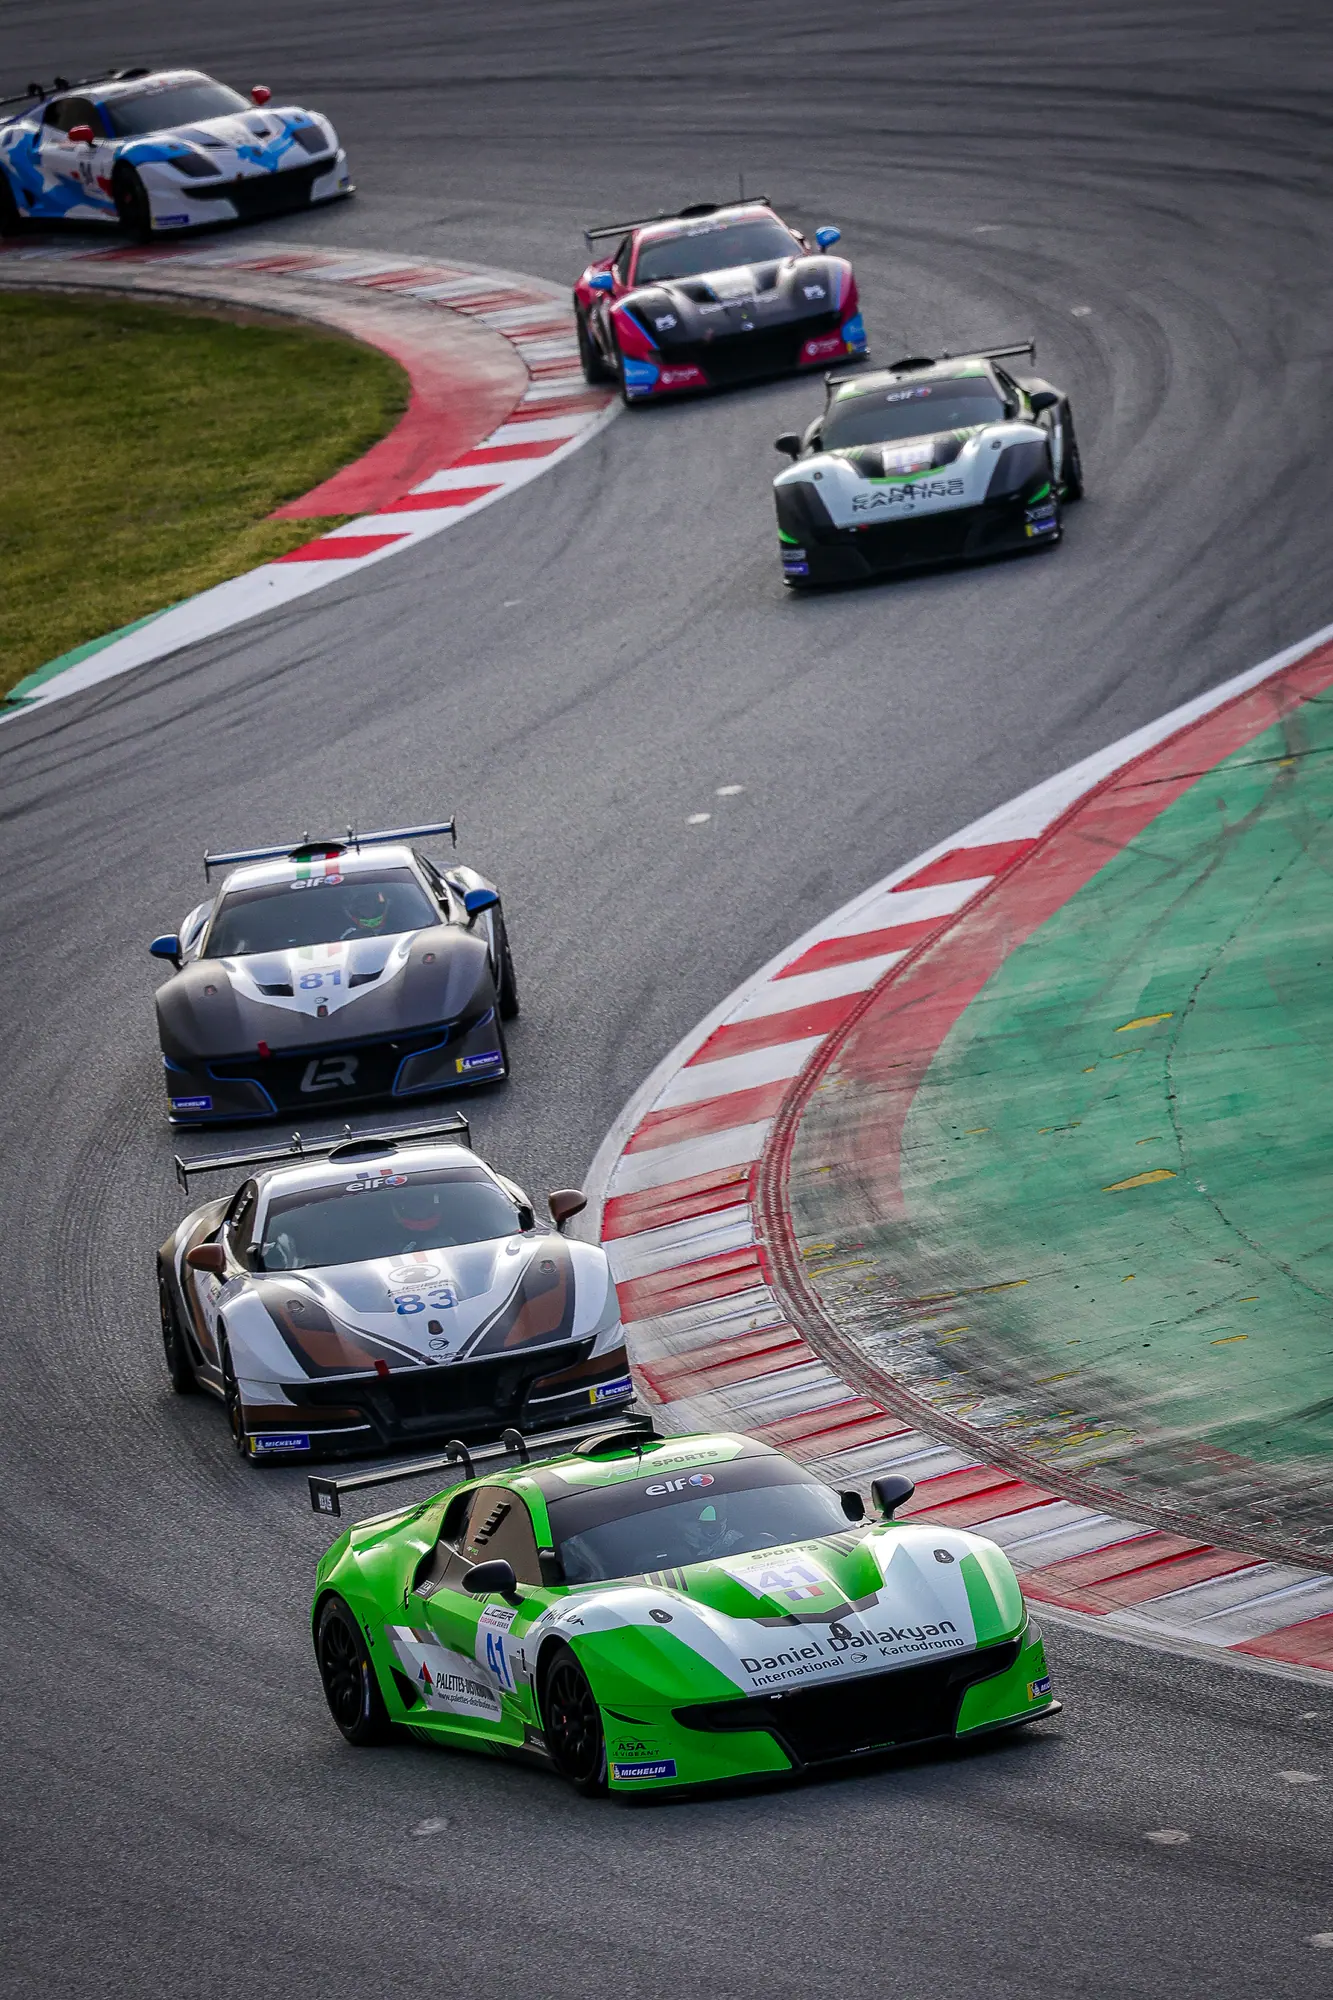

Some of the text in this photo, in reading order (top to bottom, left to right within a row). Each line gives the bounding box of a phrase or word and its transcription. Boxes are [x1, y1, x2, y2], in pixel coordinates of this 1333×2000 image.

[851, 478, 964, 503] CANNES
[852, 488, 964, 512] KARTING
[290, 877, 324, 890] elf
[300, 969, 341, 990] 81
[300, 1055, 359, 1092] LR
[346, 1178, 385, 1192] elf
[395, 1288, 459, 1315] 83
[265, 1439, 303, 1448] MICHELIN
[651, 1450, 719, 1468] SPORTS
[645, 1478, 688, 1496] elf
[751, 1544, 819, 1560] SPORTS
[759, 1565, 820, 1589] 41
[479, 1616, 497, 1626] EUROPEAN
[483, 1606, 515, 1622] LIGIER
[739, 1620, 958, 1674] Daniel Dallakyan
[486, 1632, 512, 1688] 41
[751, 1636, 966, 1687] International Kartodromo
[617, 1742, 647, 1751] ASA
[620, 1749, 660, 1757] VIGEANT
[621, 1766, 667, 1777] MICHELIN
